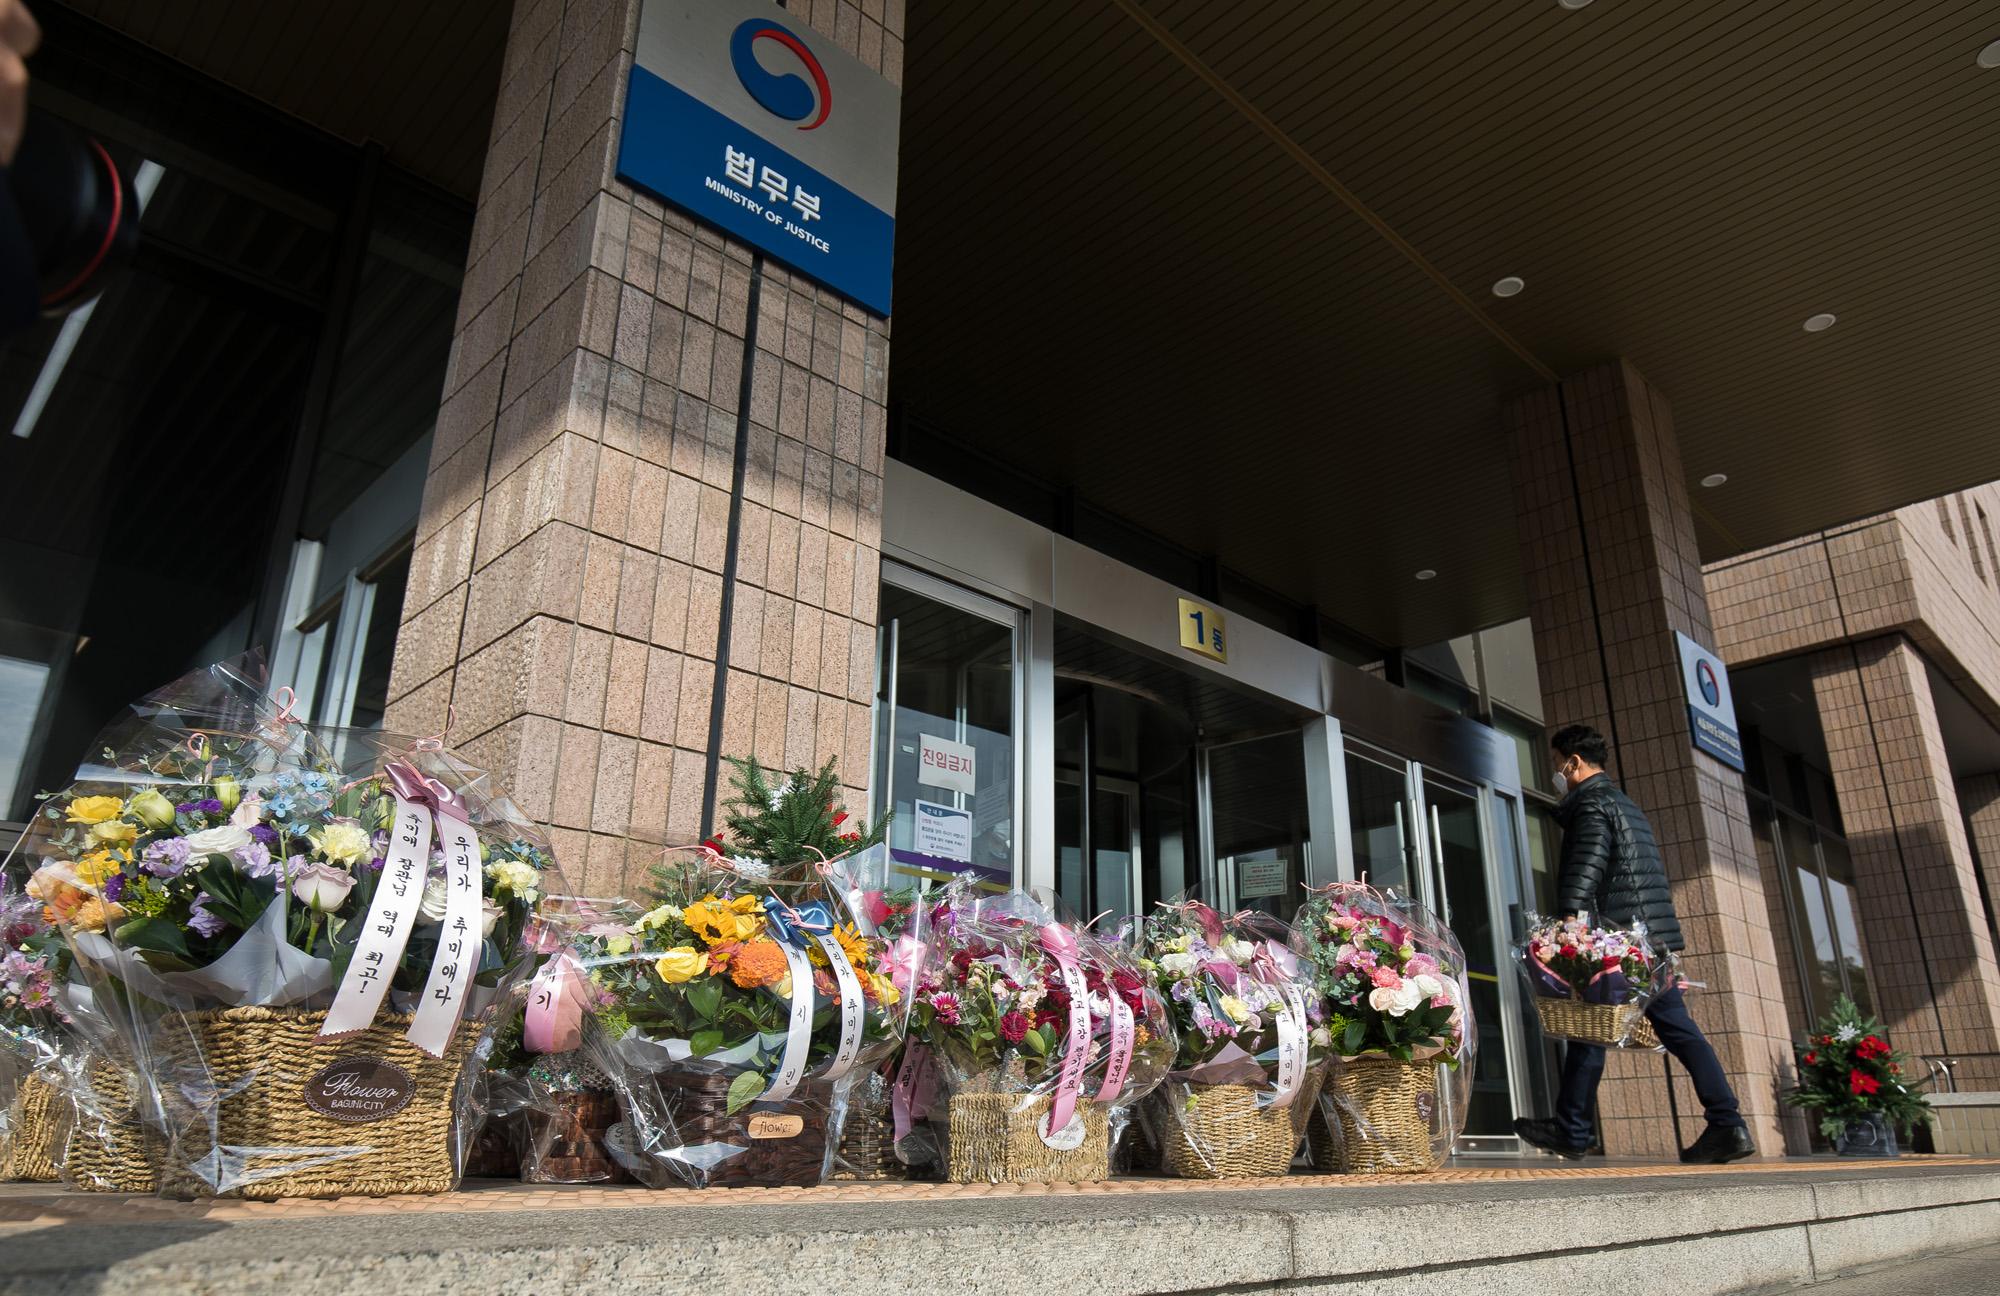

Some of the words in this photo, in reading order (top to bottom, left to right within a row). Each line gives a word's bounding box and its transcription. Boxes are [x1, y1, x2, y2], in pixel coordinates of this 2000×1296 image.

[725, 145, 821, 222] 법무부
[705, 176, 764, 215] MINISTRY
[765, 210, 783, 225] OF
[784, 221, 830, 254] JUSTICE
[922, 747, 973, 776] 진입금지
[402, 812, 424, 848] 추미애
[392, 857, 416, 897] 장관님
[454, 836, 472, 893] 우리가
[377, 910, 398, 938] 역대
[358, 950, 384, 994] 최고!
[434, 916, 468, 1007] 추미애다
[825, 937, 850, 979] 우리가
[840, 998, 858, 1066] 추미애다
[1067, 966, 1085, 1010] 힘내시고
[1076, 1016, 1088, 1040] 건강
[322, 1071, 400, 1099] Flower
[1283, 1042, 1295, 1088] 추미애
[759, 1120, 794, 1136] flower
